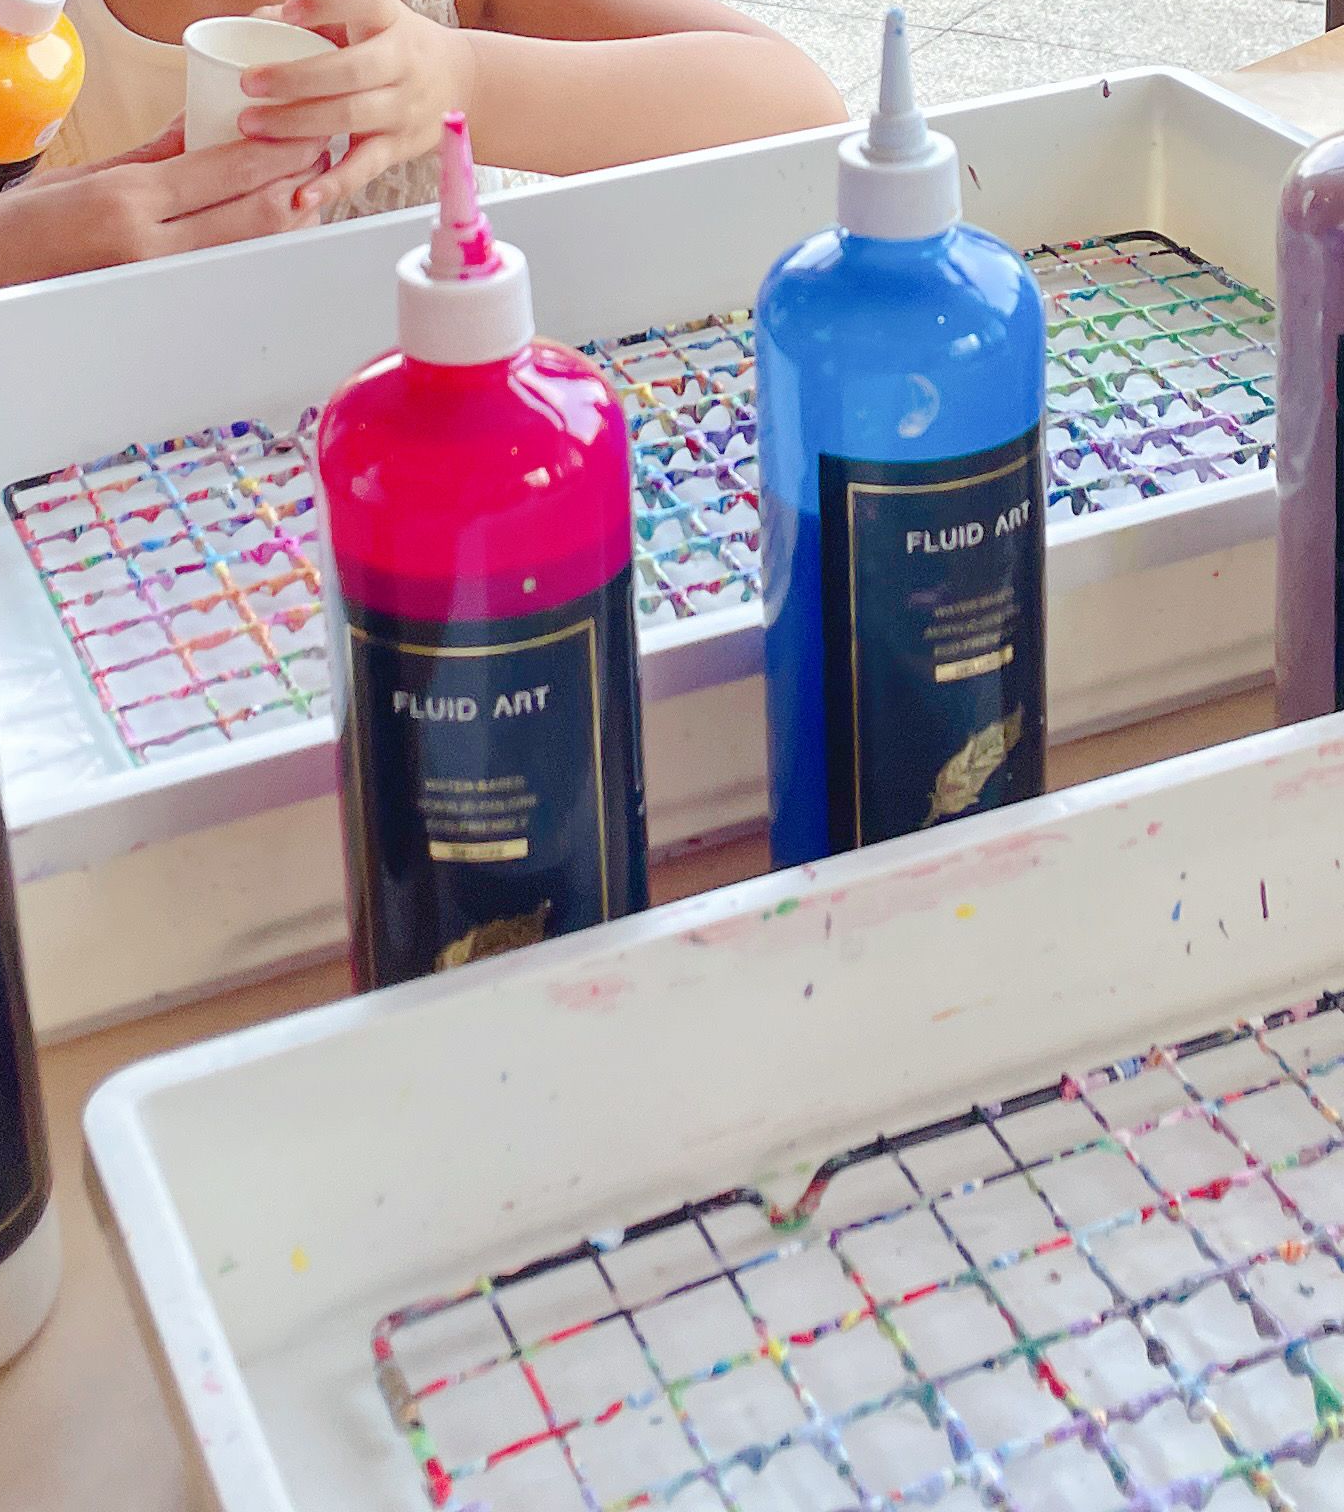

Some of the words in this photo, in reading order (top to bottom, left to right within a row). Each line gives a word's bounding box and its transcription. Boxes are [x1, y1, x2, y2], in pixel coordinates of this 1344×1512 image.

[907, 522, 984, 554] FLUID
[995, 499, 1031, 537] ART
[392, 690, 477, 722] FLUID
[493, 683, 550, 719] ART
